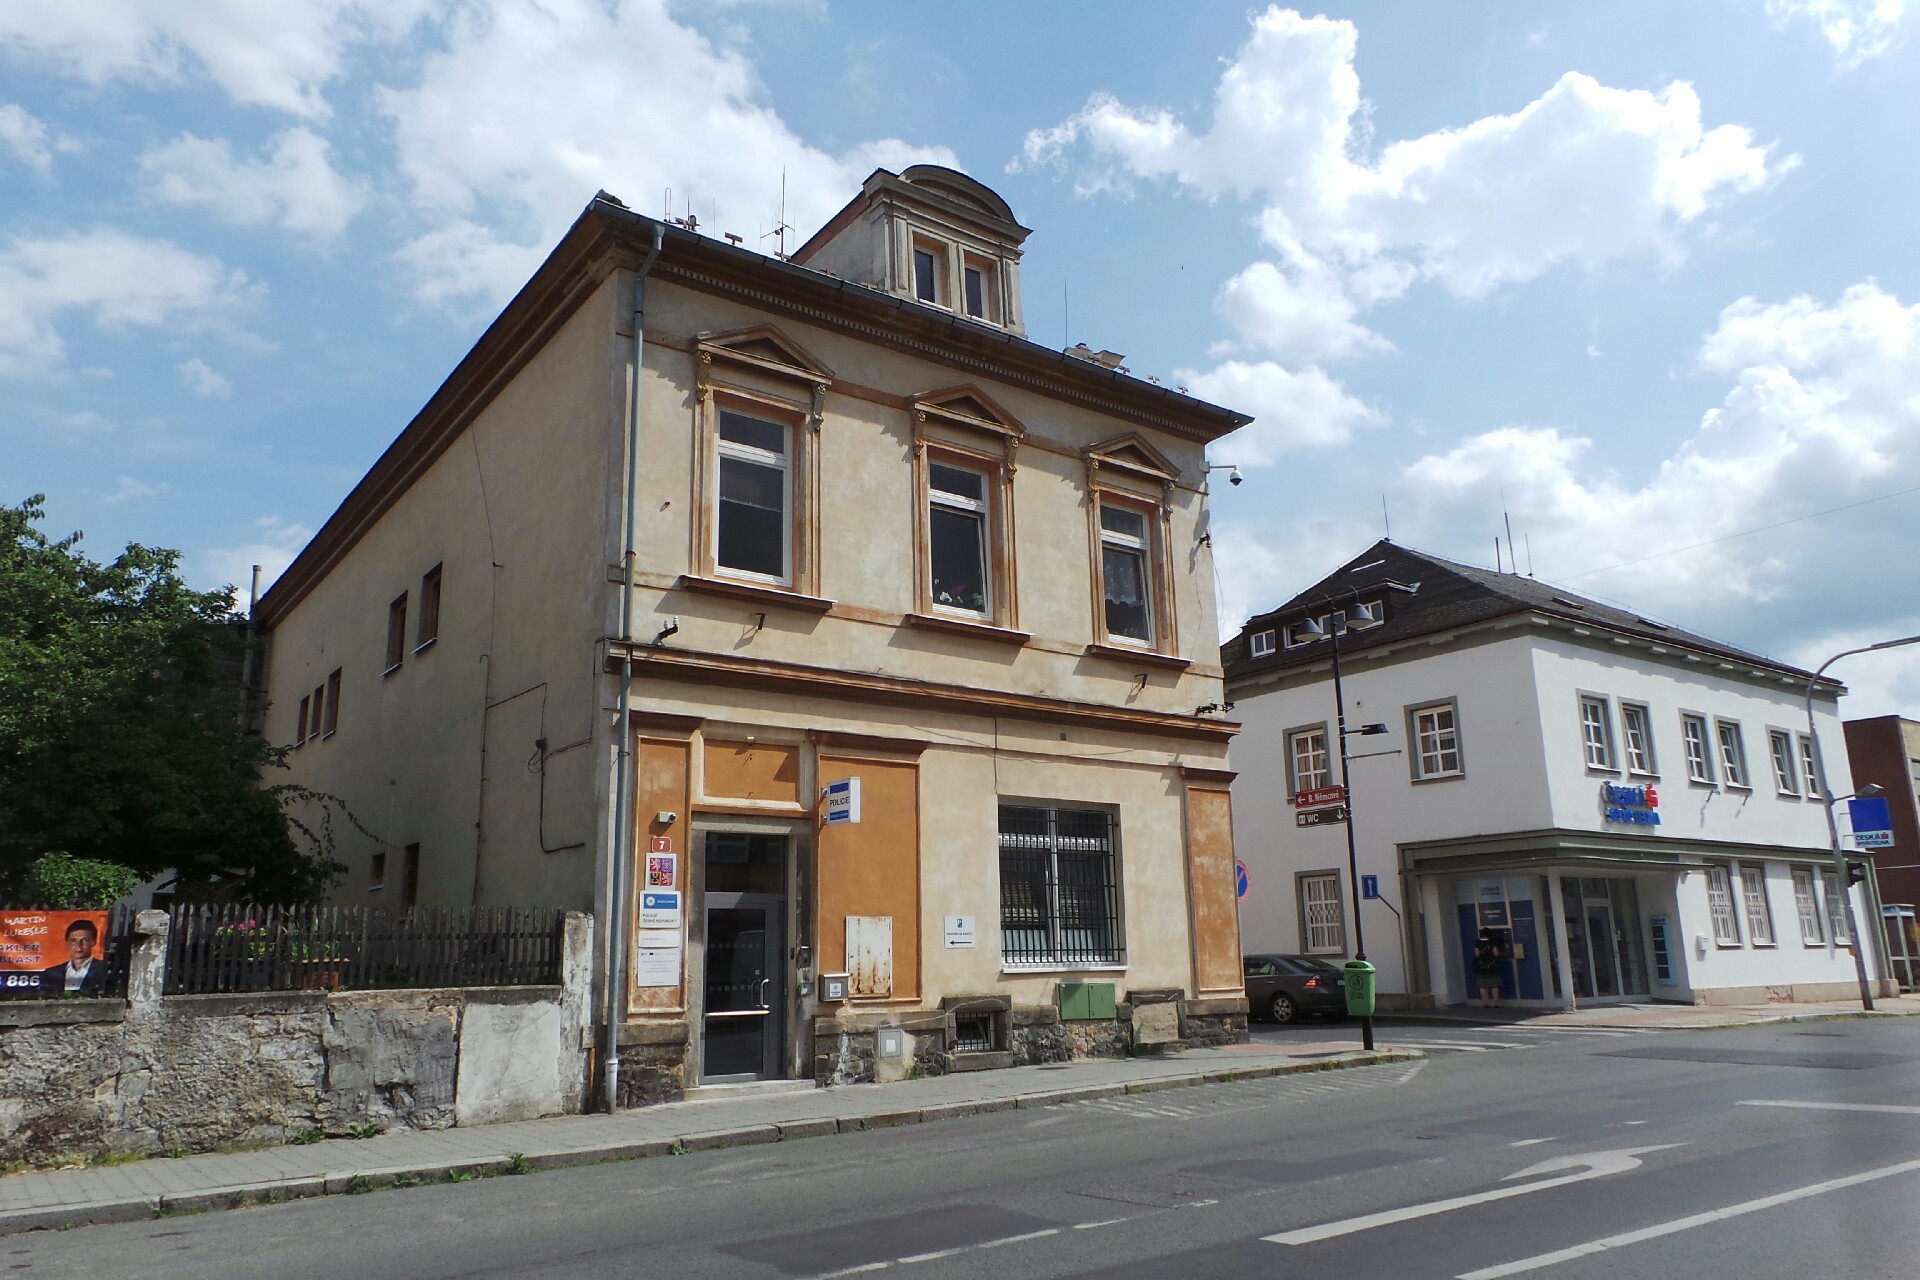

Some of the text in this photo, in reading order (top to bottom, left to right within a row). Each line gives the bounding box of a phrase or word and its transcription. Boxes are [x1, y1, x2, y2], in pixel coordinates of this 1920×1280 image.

[1308, 794, 1315, 803] B.
[1306, 813, 1319, 823] WC
[659, 840, 665, 850] 7
[4, 915, 46, 926] MARTIN
[7, 975, 40, 987] 886
